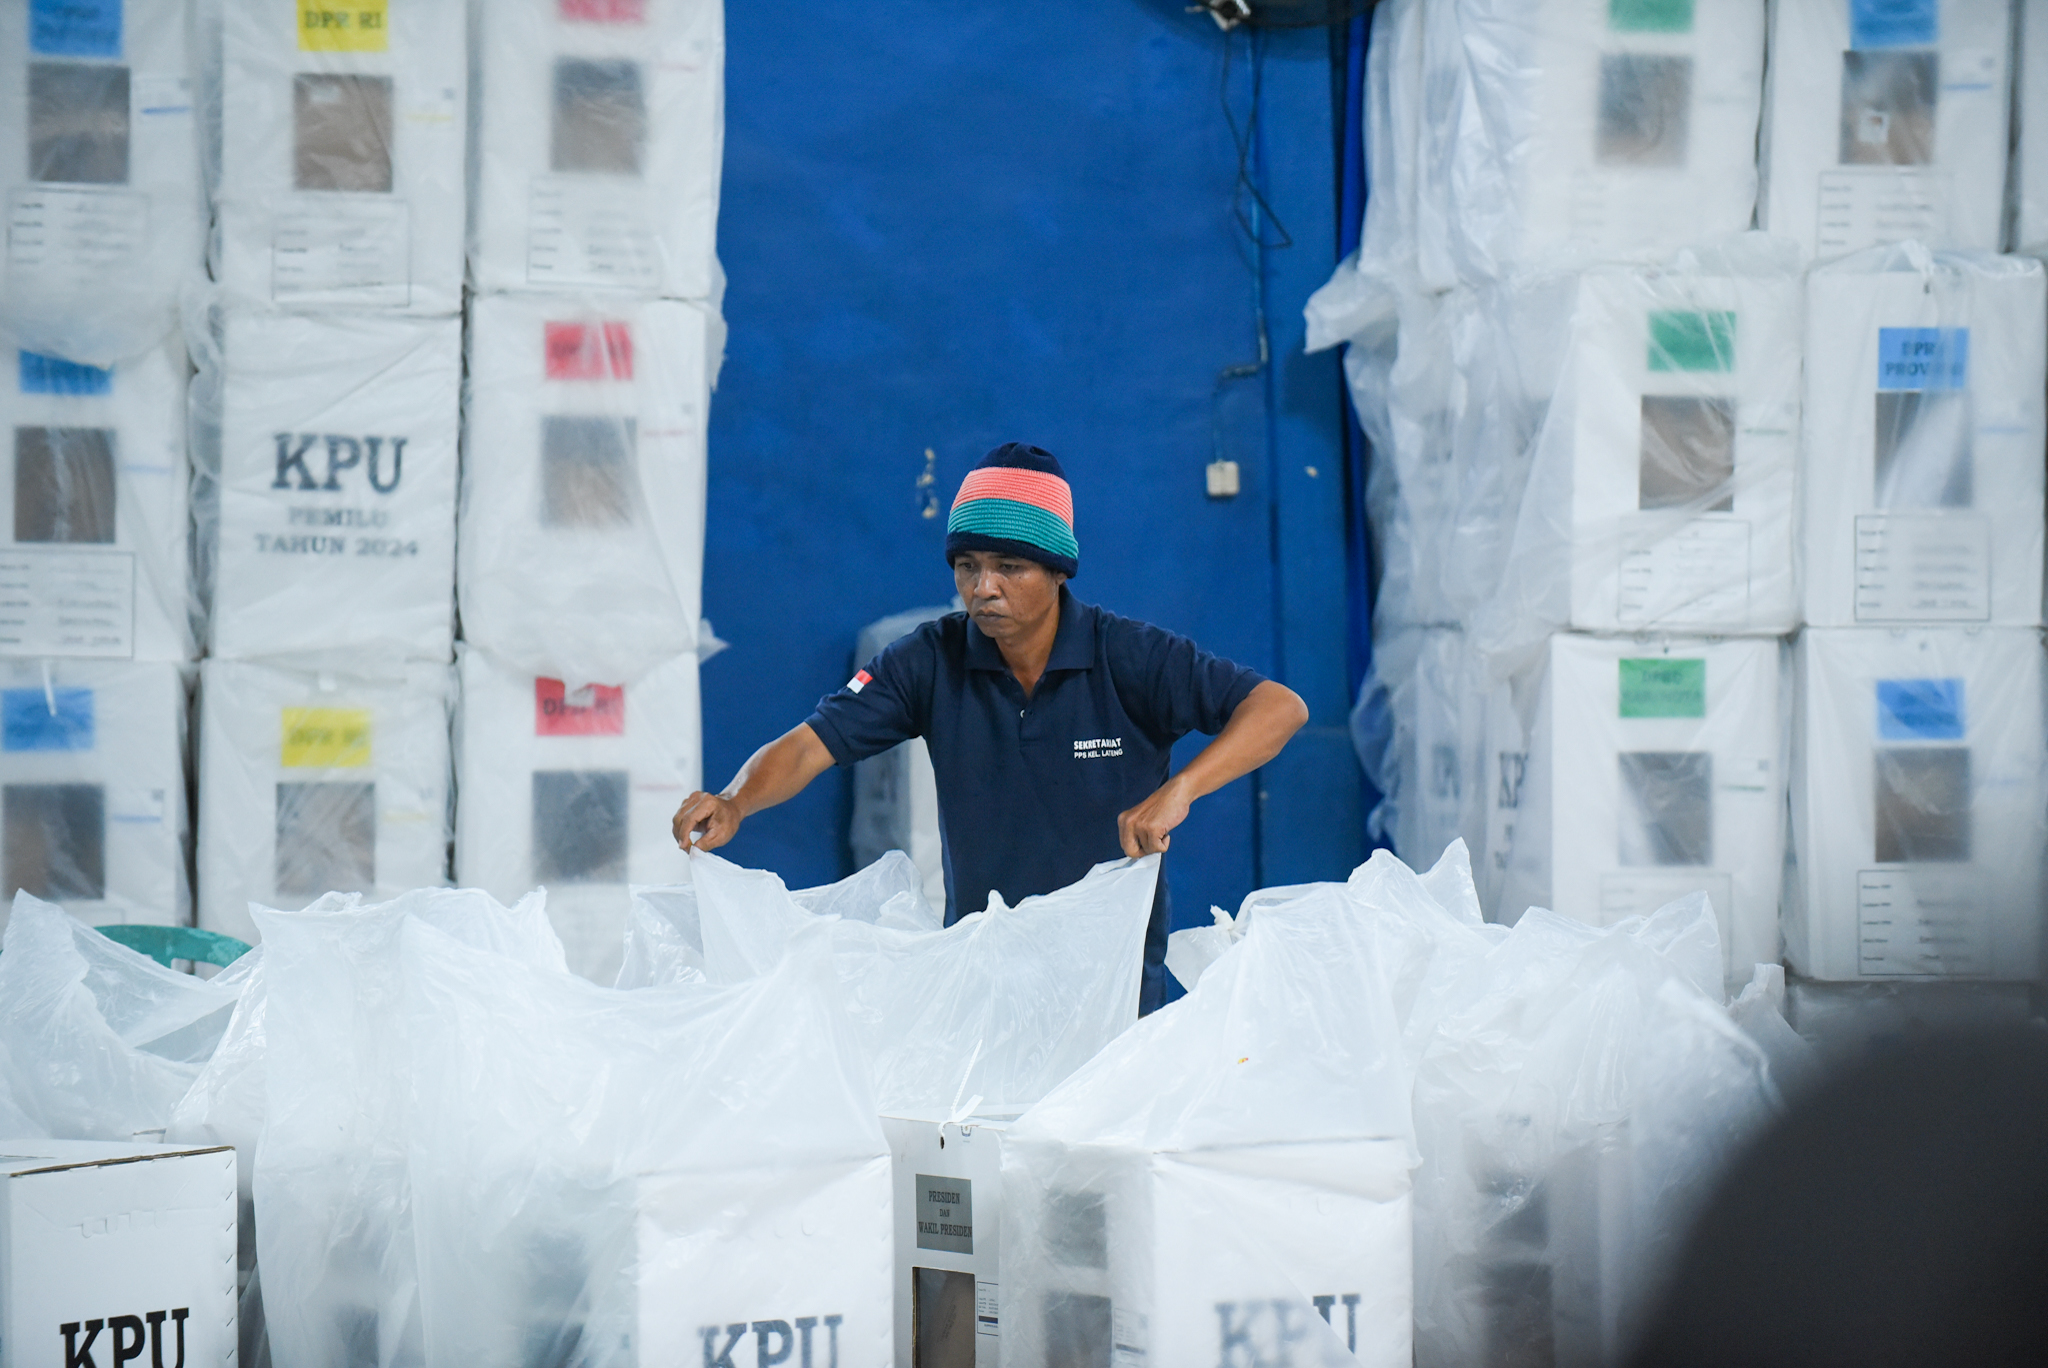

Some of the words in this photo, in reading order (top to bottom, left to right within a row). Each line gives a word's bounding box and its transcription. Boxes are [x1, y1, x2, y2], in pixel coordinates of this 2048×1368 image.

[304, 10, 350, 29] DPR
[270, 432, 408, 495] KPU
[287, 505, 389, 529] PEMILU
[254, 532, 345, 555] TAHUN
[355, 536, 419, 557] 2024
[1073, 737, 1121, 750] SEKRETARIAT
[1074, 751, 1087, 759] PPS
[928, 1190, 961, 1204] PRESIDEN
[939, 1208, 950, 1217] DAN
[918, 1221, 939, 1234] WAKIL
[940, 1223, 973, 1238] PRESIDEN
[60, 1307, 189, 1368] KPU
[698, 1314, 843, 1368] KPU
[1215, 1294, 1361, 1368] KPU
